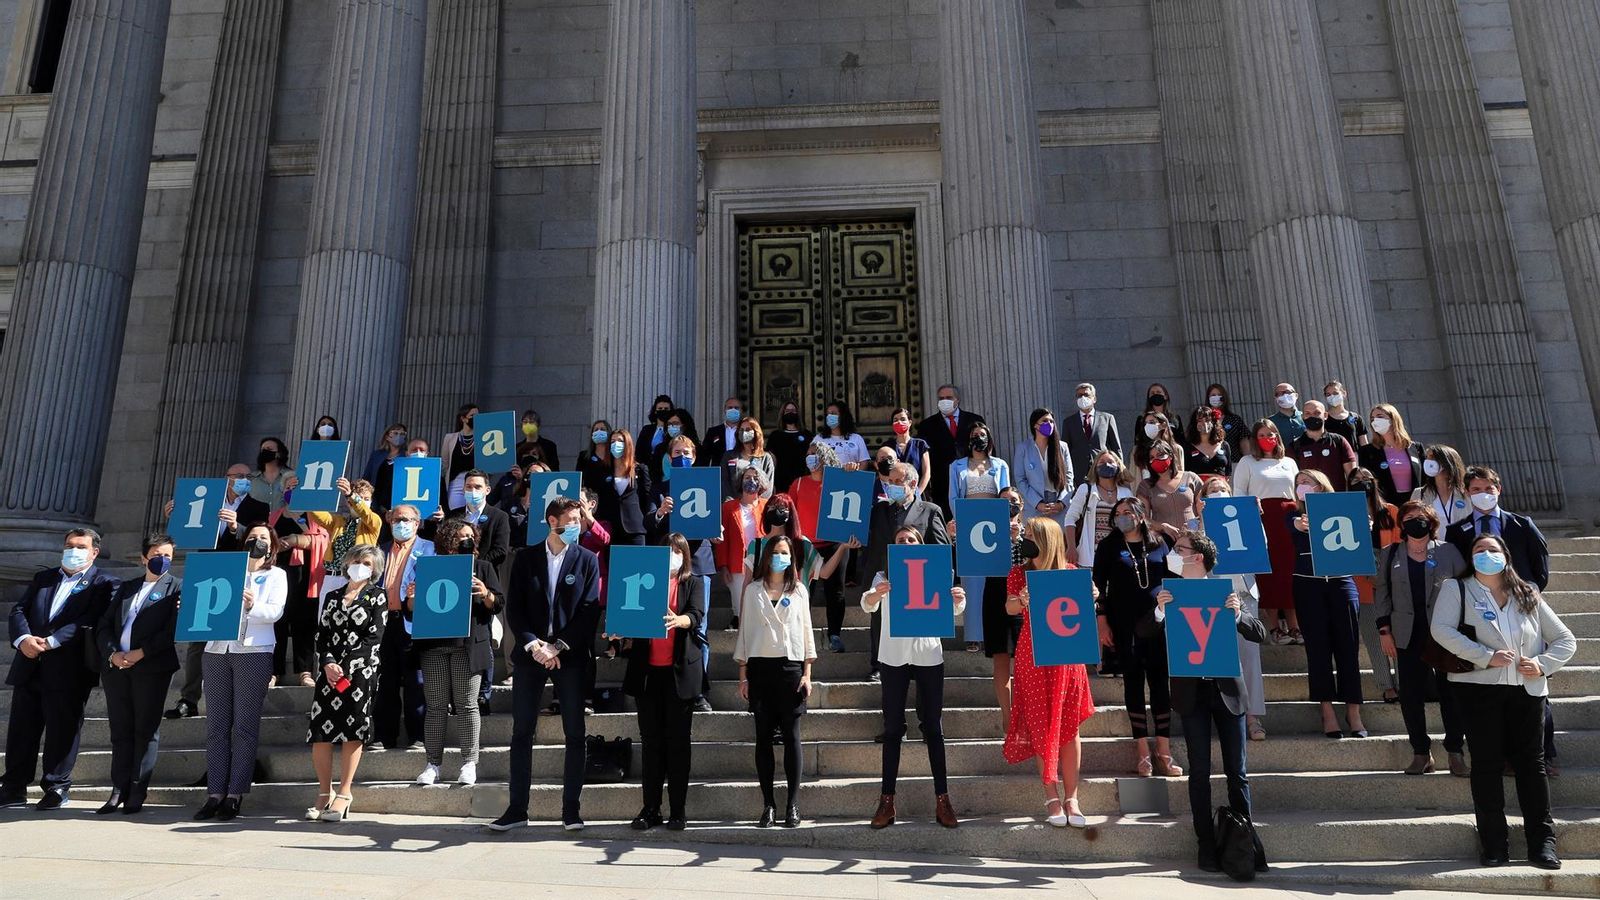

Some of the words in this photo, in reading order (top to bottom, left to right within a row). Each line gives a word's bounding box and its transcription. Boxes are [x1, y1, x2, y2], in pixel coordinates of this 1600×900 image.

[481, 429, 508, 457] a
[299, 460, 334, 491] n
[401, 466, 431, 502] L
[183, 485, 205, 528] i
[540, 478, 570, 524] f
[679, 487, 711, 519] a
[826, 489, 862, 523] n
[969, 520, 998, 554] c
[1221, 504, 1248, 552] i
[1320, 515, 1361, 552] a
[425, 578, 460, 614] o
[620, 572, 656, 611] r
[902, 558, 941, 611] L
[187, 577, 233, 632] p
[1045, 596, 1082, 638] e
[1177, 606, 1222, 666] y
